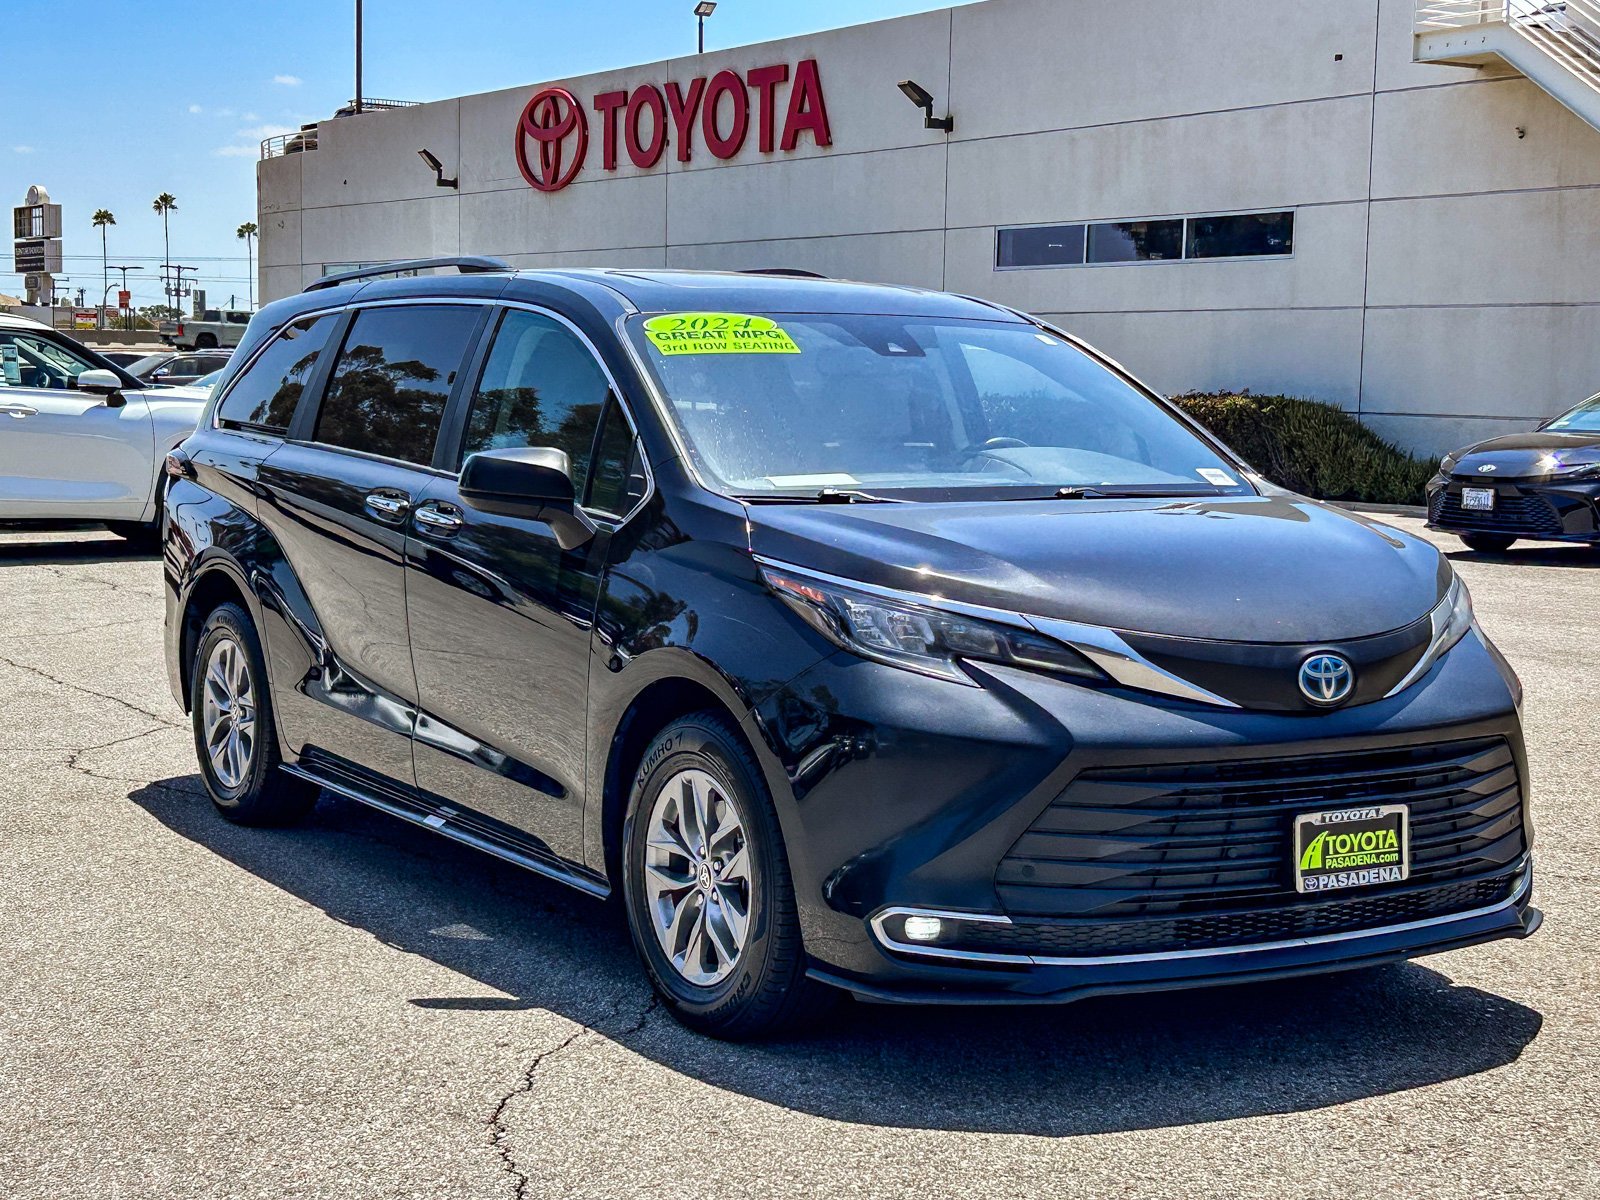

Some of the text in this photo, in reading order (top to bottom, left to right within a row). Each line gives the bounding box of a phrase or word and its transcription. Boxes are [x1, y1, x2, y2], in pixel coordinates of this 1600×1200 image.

[593, 59, 833, 171] TOYOTA
[671, 317, 753, 331] 2024
[655, 330, 781, 341] GREAT MPG
[662, 341, 795, 352] 3rd ROW SEATING
[637, 738, 673, 788] KUMHO
[1323, 809, 1377, 823] TOYOTA
[1325, 829, 1399, 855] TOYOTA
[1325, 853, 1399, 869] PASADENA.com
[1319, 867, 1402, 889] PASADENA
